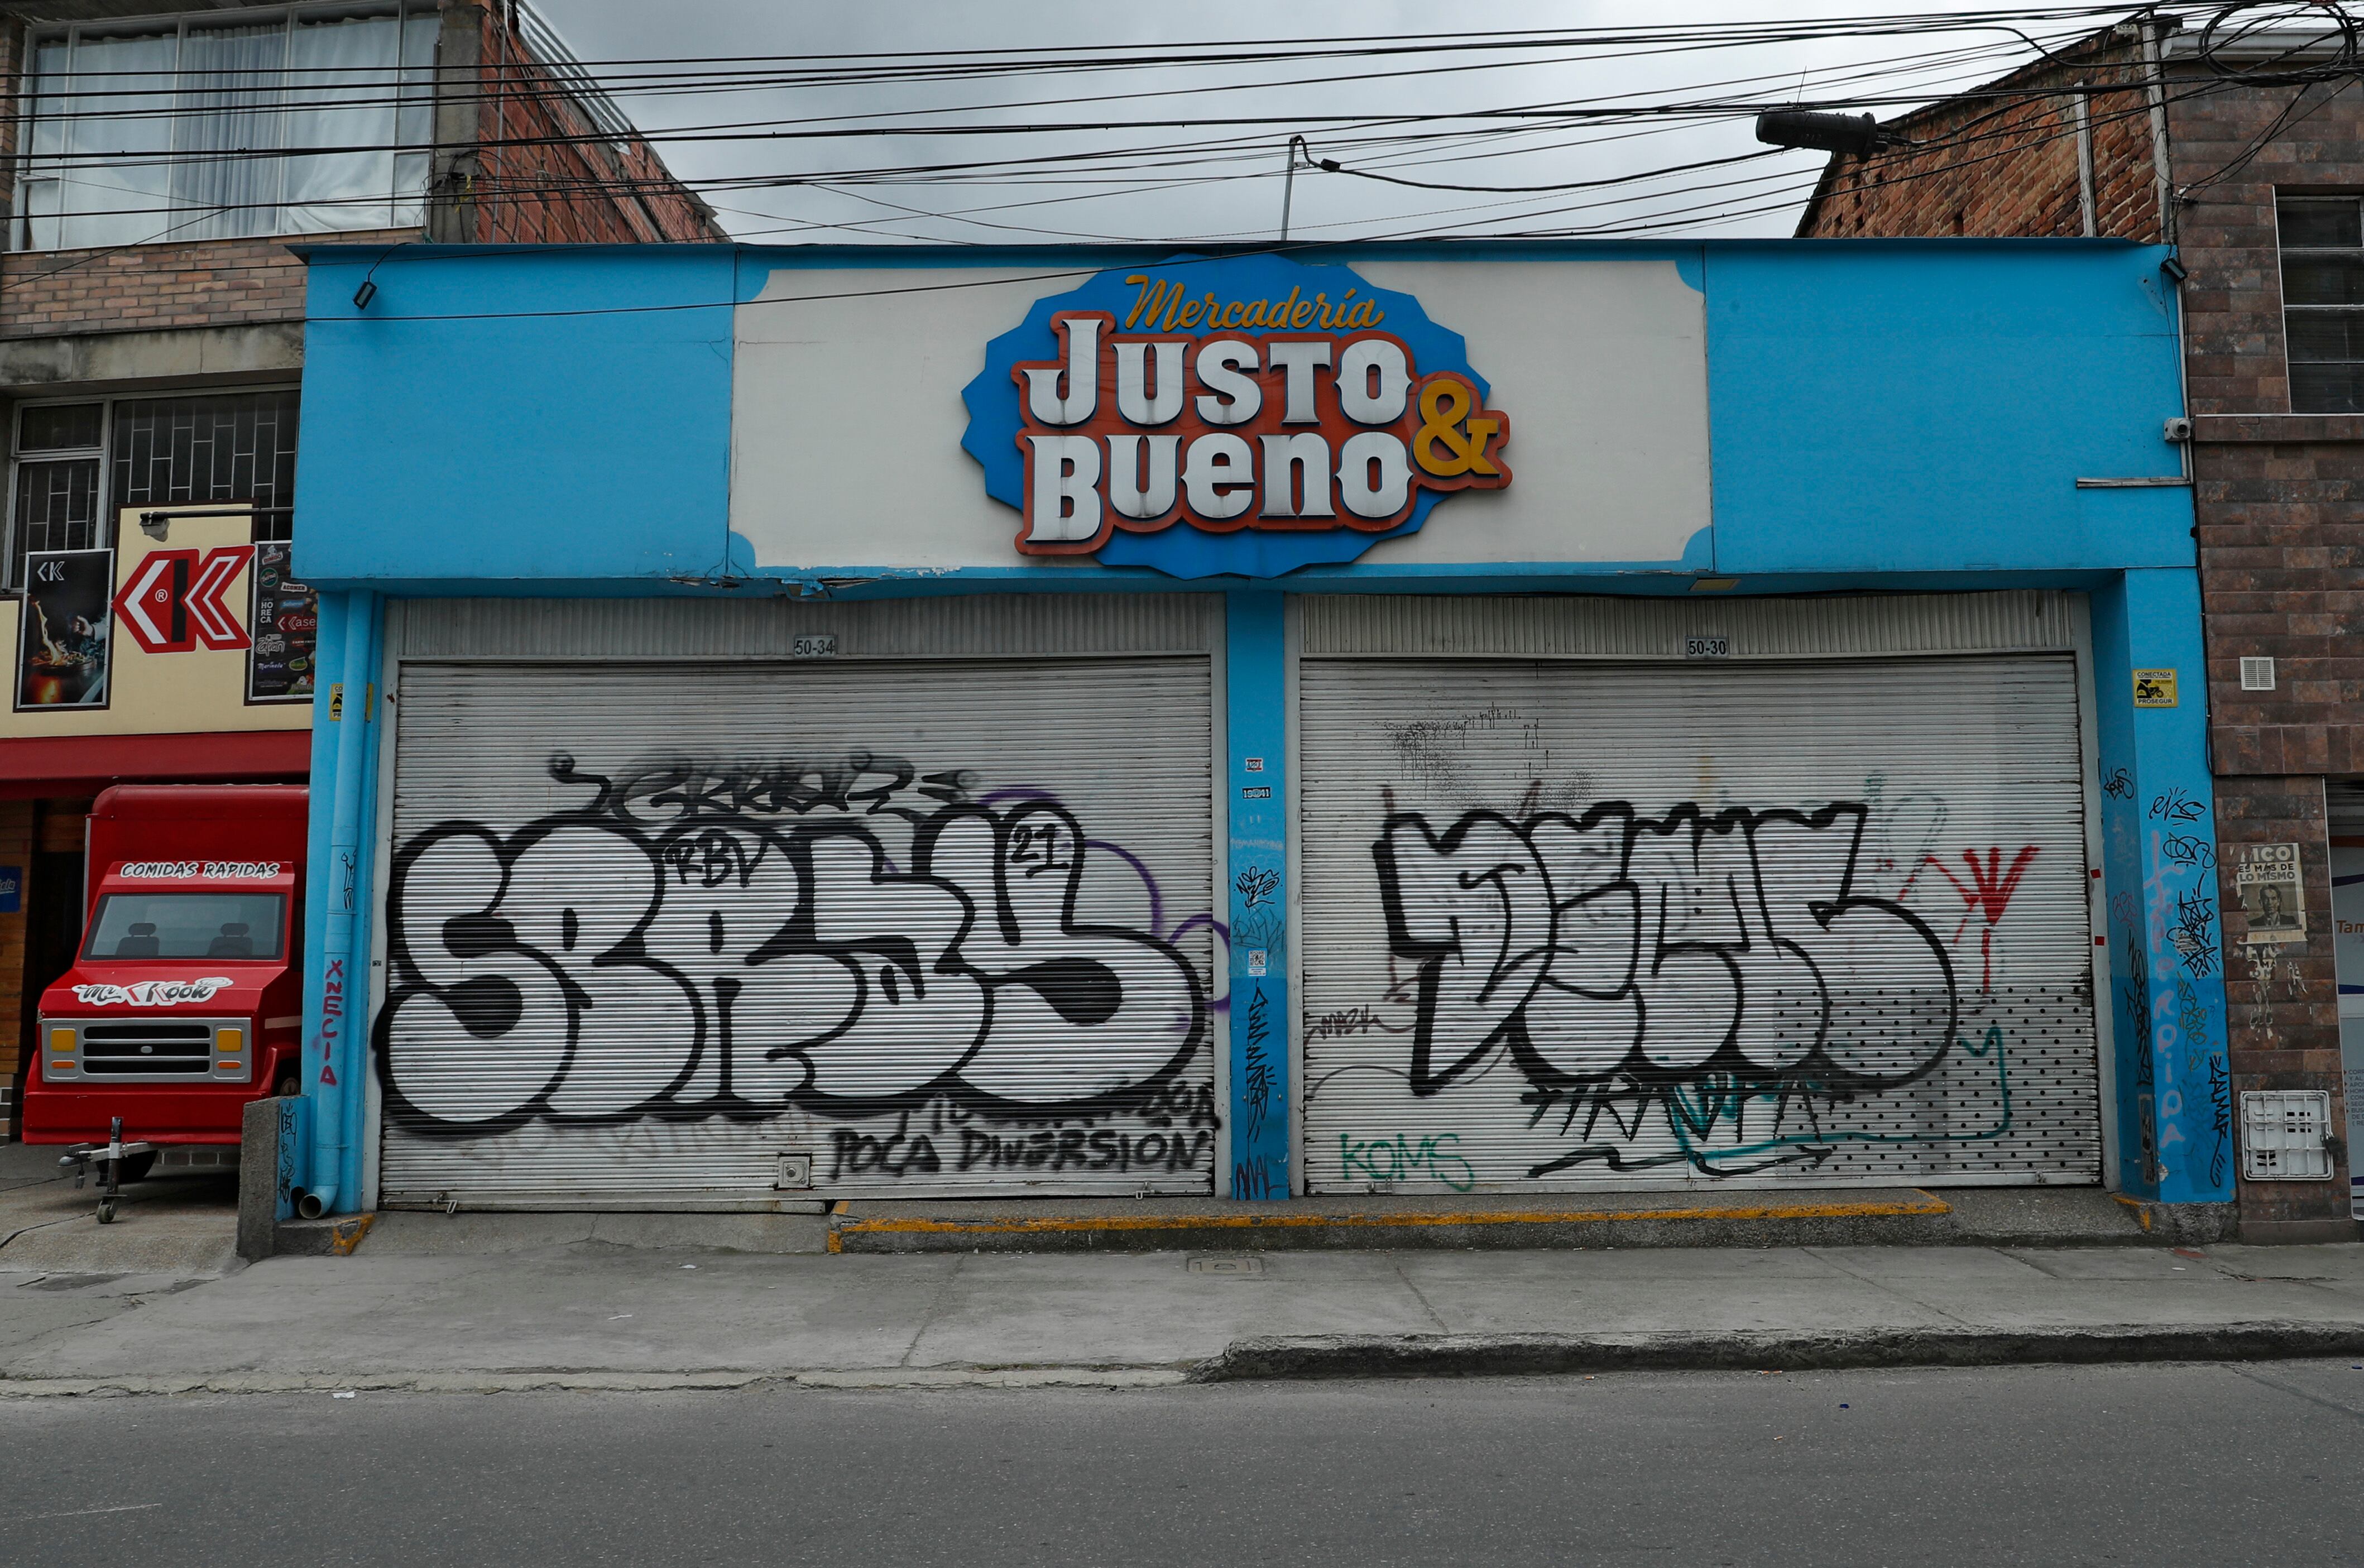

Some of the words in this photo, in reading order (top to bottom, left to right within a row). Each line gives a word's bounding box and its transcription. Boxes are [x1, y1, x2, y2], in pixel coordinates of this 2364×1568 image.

[1124, 274, 1384, 333] Mercadería
[1022, 318, 1413, 428] JUSTO
[795, 639, 835, 655] 50-34
[1688, 640, 1727, 655] 50-30
[2241, 845, 2291, 862] ICO
[121, 862, 198, 879] COMIDAS
[203, 862, 280, 879] RAPIDAS
[2240, 873, 2255, 882] LO
[1340, 1132, 1475, 1193] KOMS
